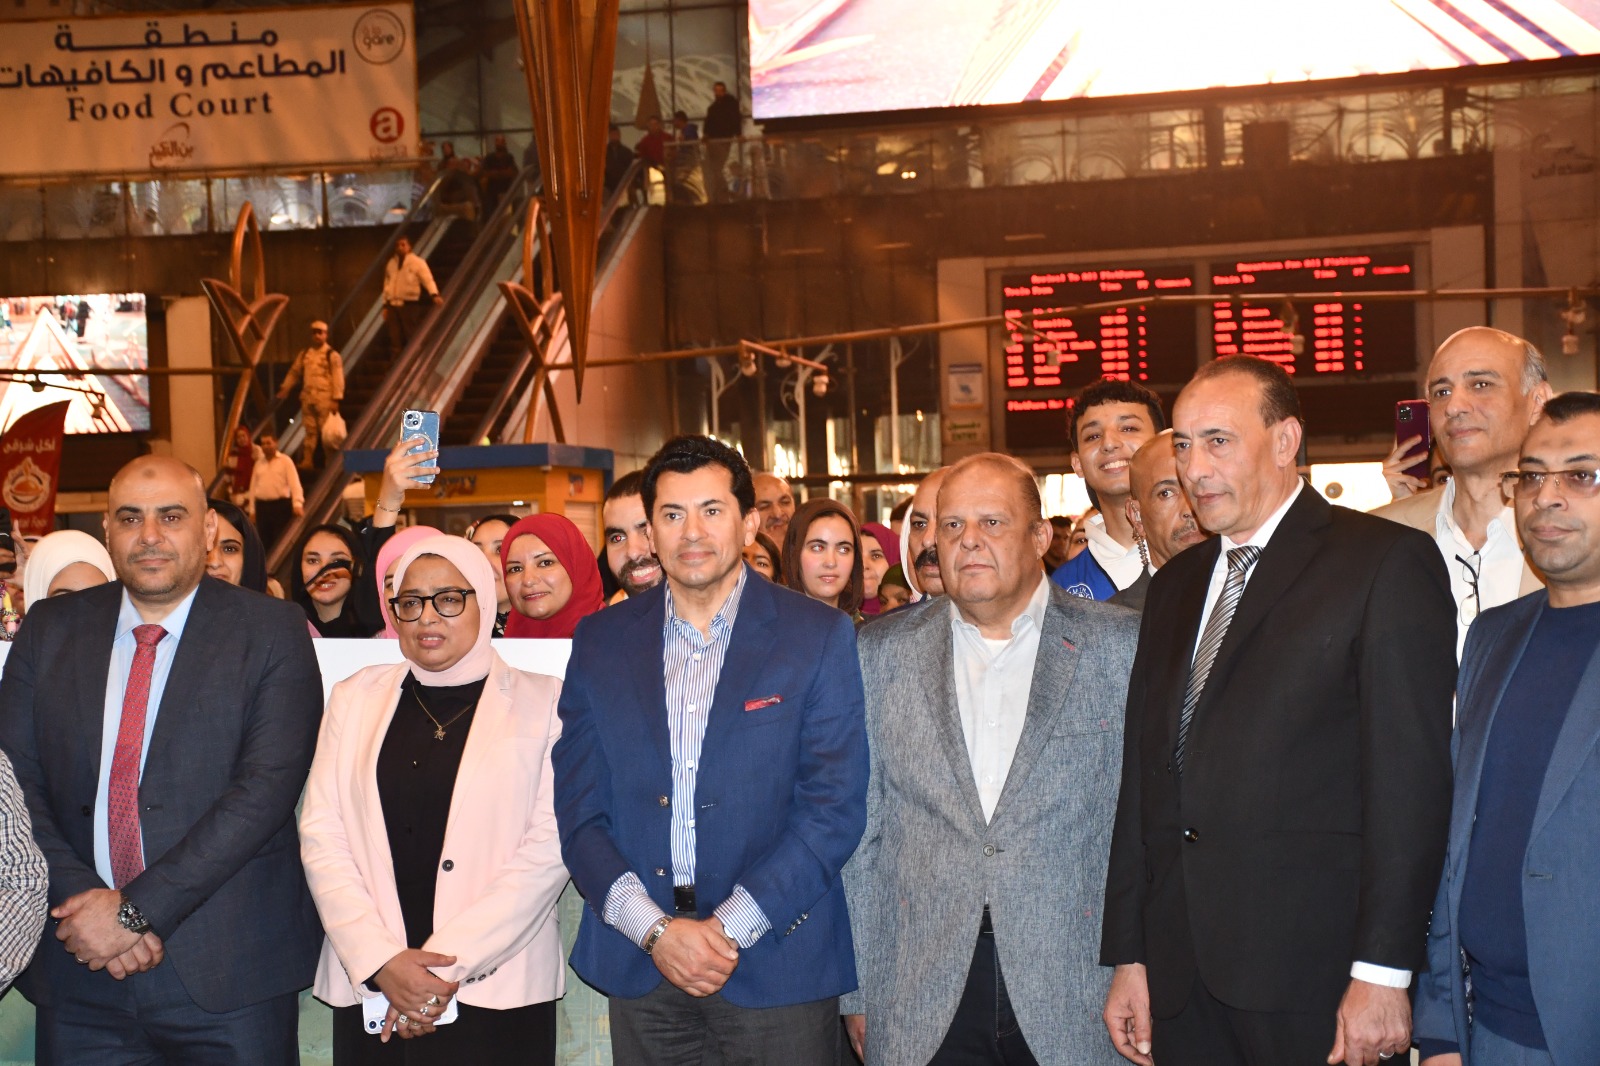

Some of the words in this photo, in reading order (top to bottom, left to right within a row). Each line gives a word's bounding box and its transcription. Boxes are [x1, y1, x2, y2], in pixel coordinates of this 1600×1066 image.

[175, 64, 193, 87] و
[202, 49, 345, 87] المطاعم
[67, 93, 153, 121] Food
[170, 92, 272, 118] Court
